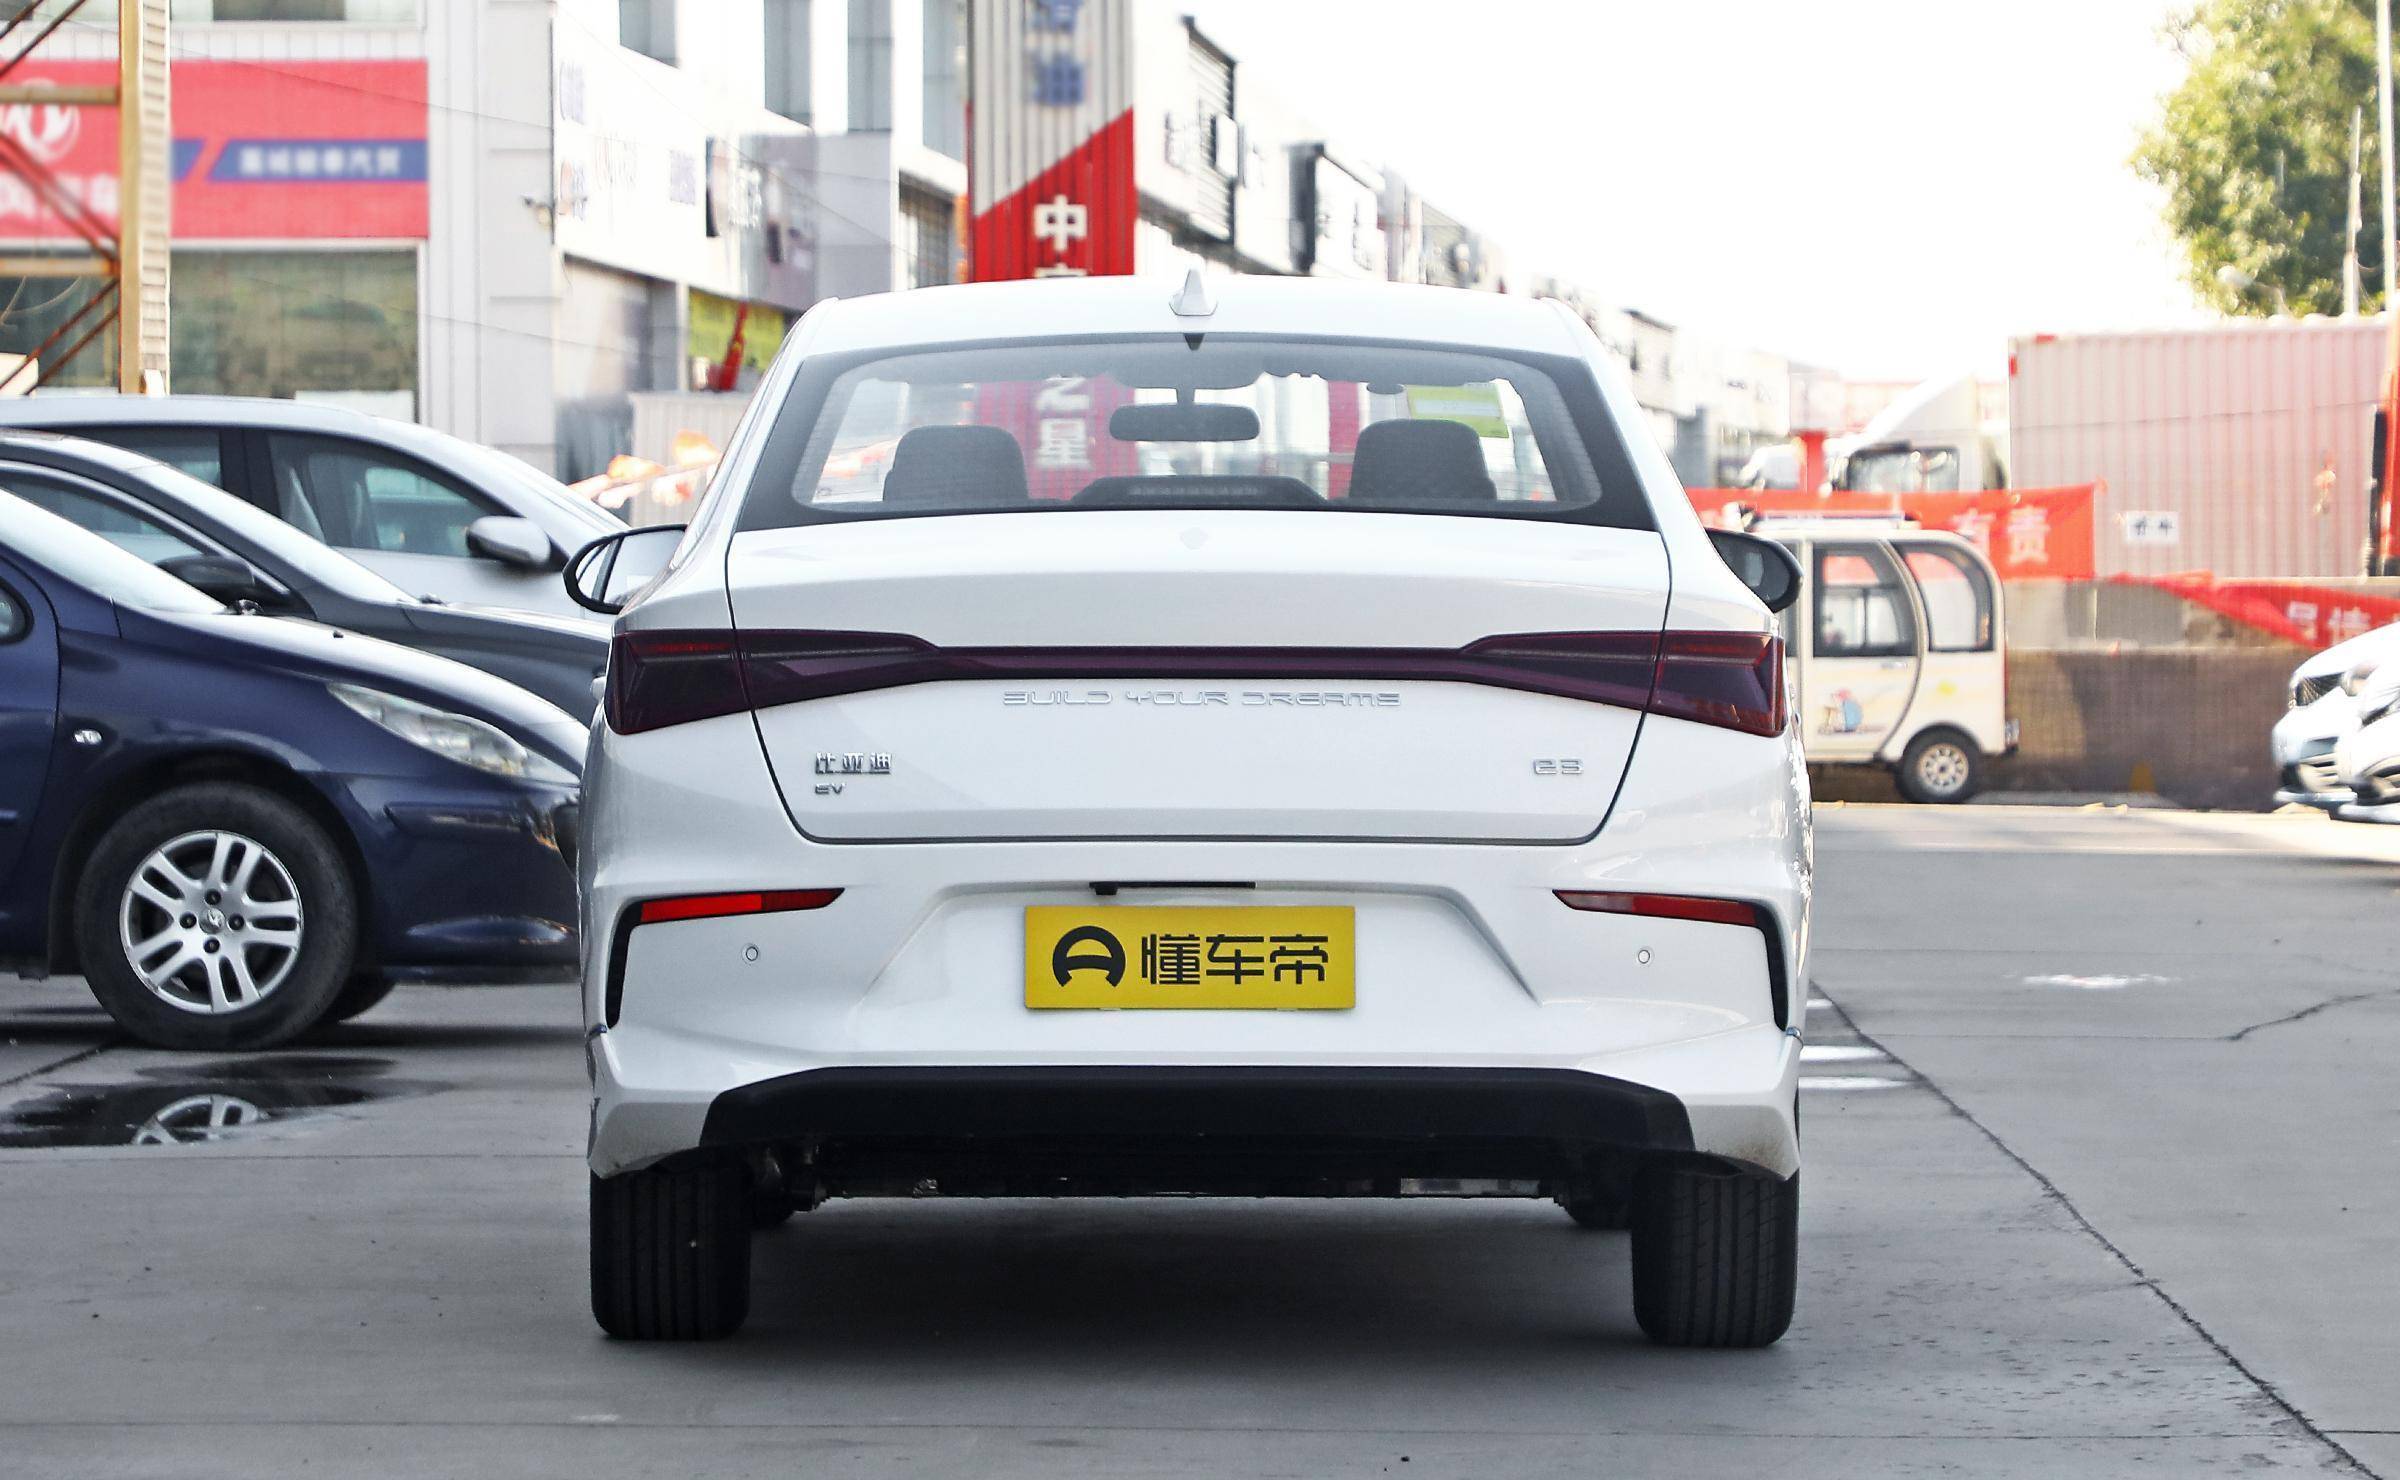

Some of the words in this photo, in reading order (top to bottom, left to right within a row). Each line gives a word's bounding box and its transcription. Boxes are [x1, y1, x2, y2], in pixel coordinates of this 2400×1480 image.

[1003, 690, 1113, 706] BUILD
[1125, 690, 1229, 706] YOUR
[1241, 690, 1401, 707] DREAMS
[814, 752, 891, 775] 比亚迪
[814, 782, 846, 795] EV
[1141, 933, 1329, 985] 懂车帝
